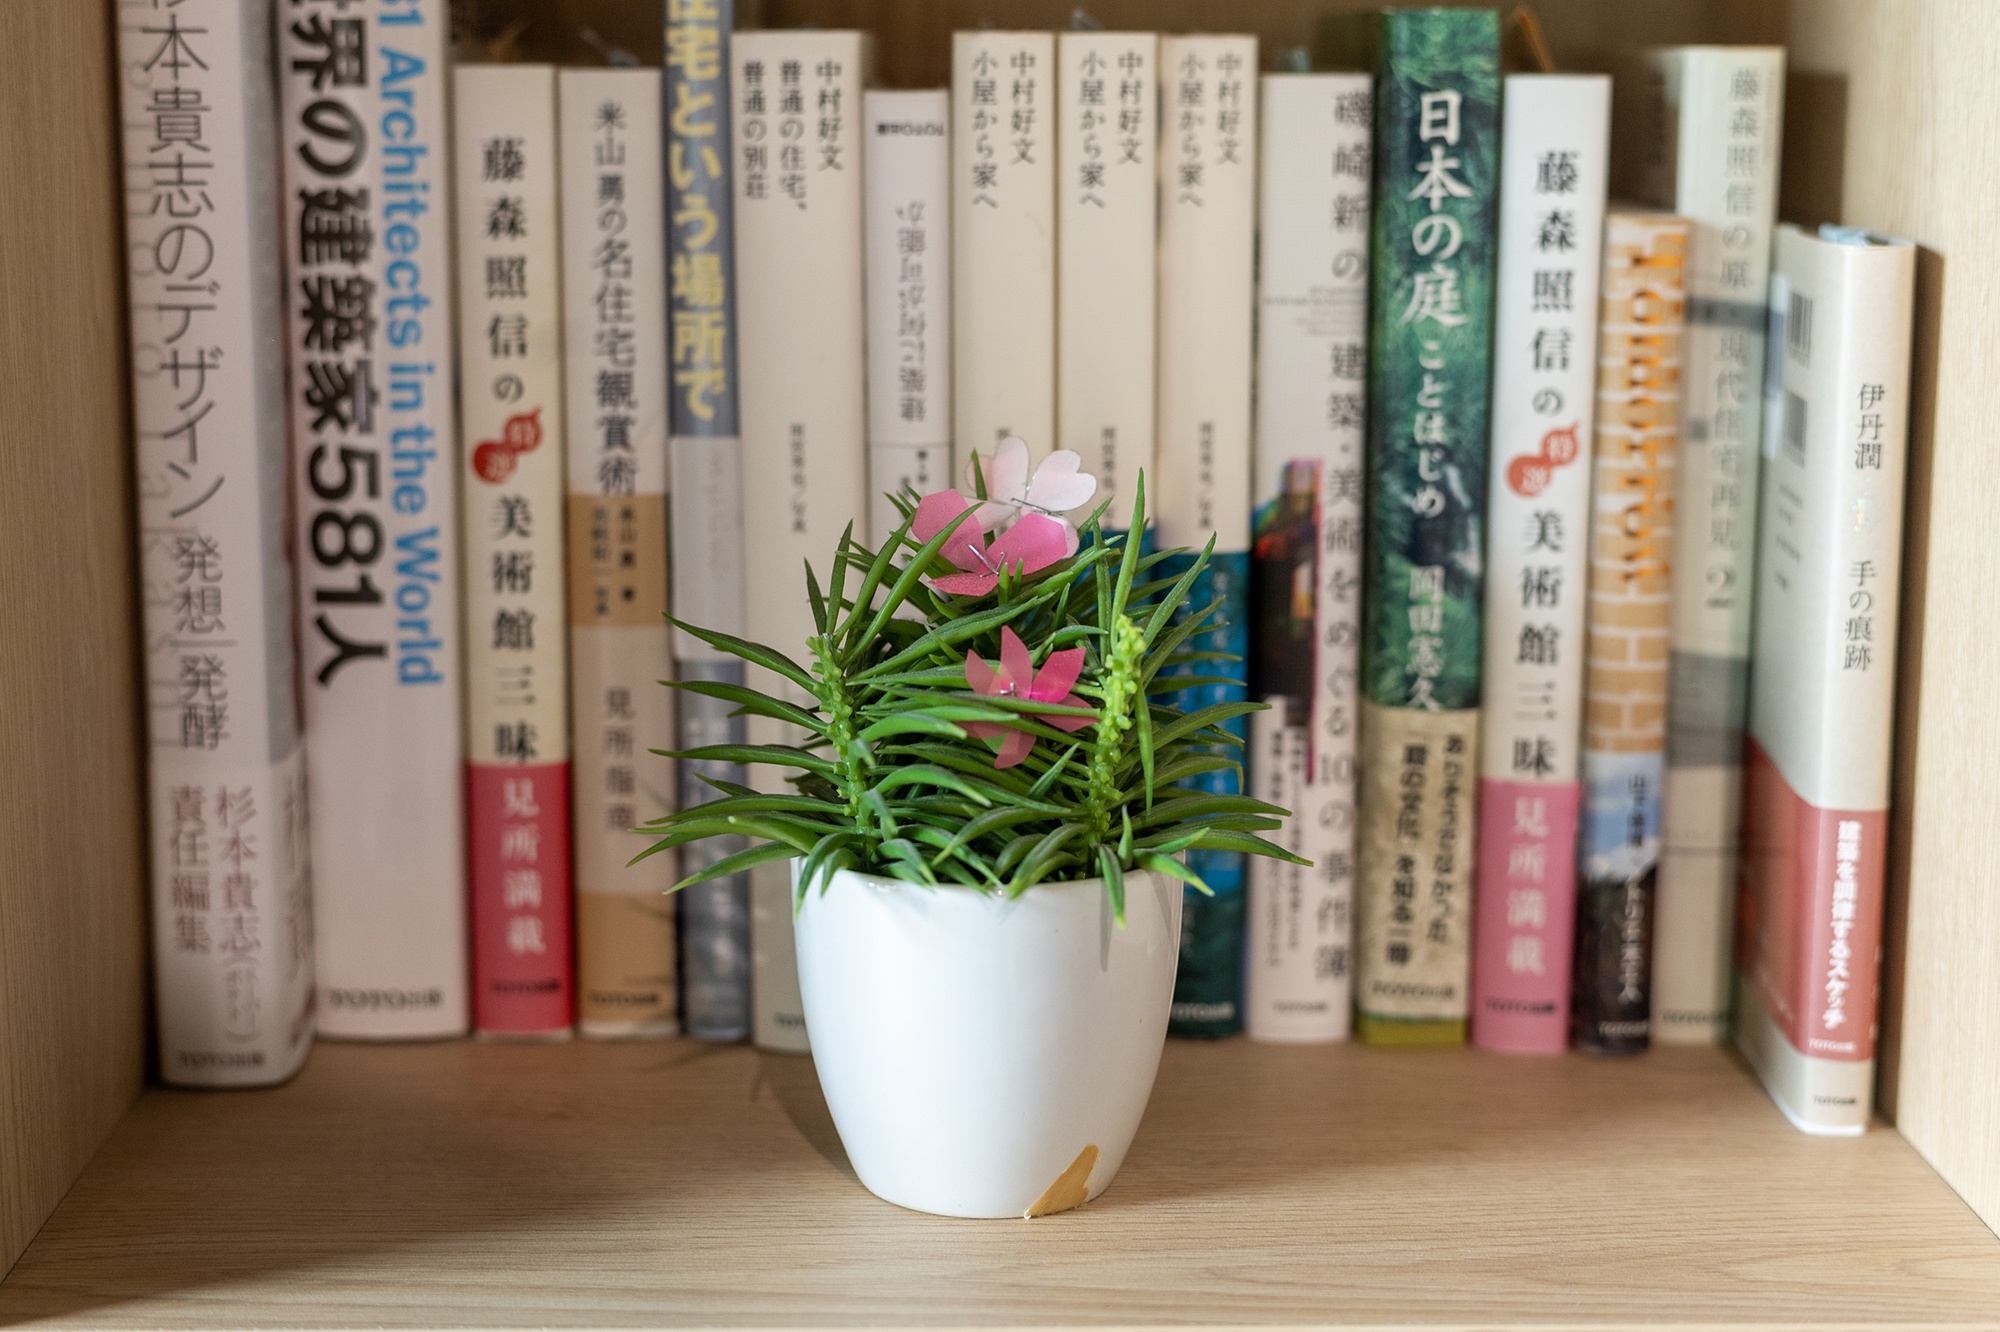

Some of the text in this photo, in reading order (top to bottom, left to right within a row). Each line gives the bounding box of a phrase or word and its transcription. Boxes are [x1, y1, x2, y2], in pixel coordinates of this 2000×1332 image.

[815, 59, 844, 171] 中村好文
[970, 49, 999, 209] 小屋から家へ
[1009, 49, 1038, 166] 中村好文
[1077, 49, 1107, 208] 小屋から家へ
[1117, 50, 1144, 166] 中村好文
[1177, 51, 1206, 208] 小屋から家へ
[1214, 51, 1243, 166] 中村好文
[141, 0, 226, 519] 本貴志のデザイン
[378, 46, 430, 349] Architects
[482, 138, 530, 404] 藤森照信の
[291, 0, 388, 689] 界の建築家581人
[1530, 149, 1582, 416] 藤森照信の
[387, 362, 436, 413] in
[389, 420, 439, 516] the
[1843, 383, 1885, 672] 伊丹潤 手の痕跡
[394, 526, 445, 686] World
[490, 496, 538, 765] 美術館三昧
[1514, 508, 1565, 779] 美術館三昧
